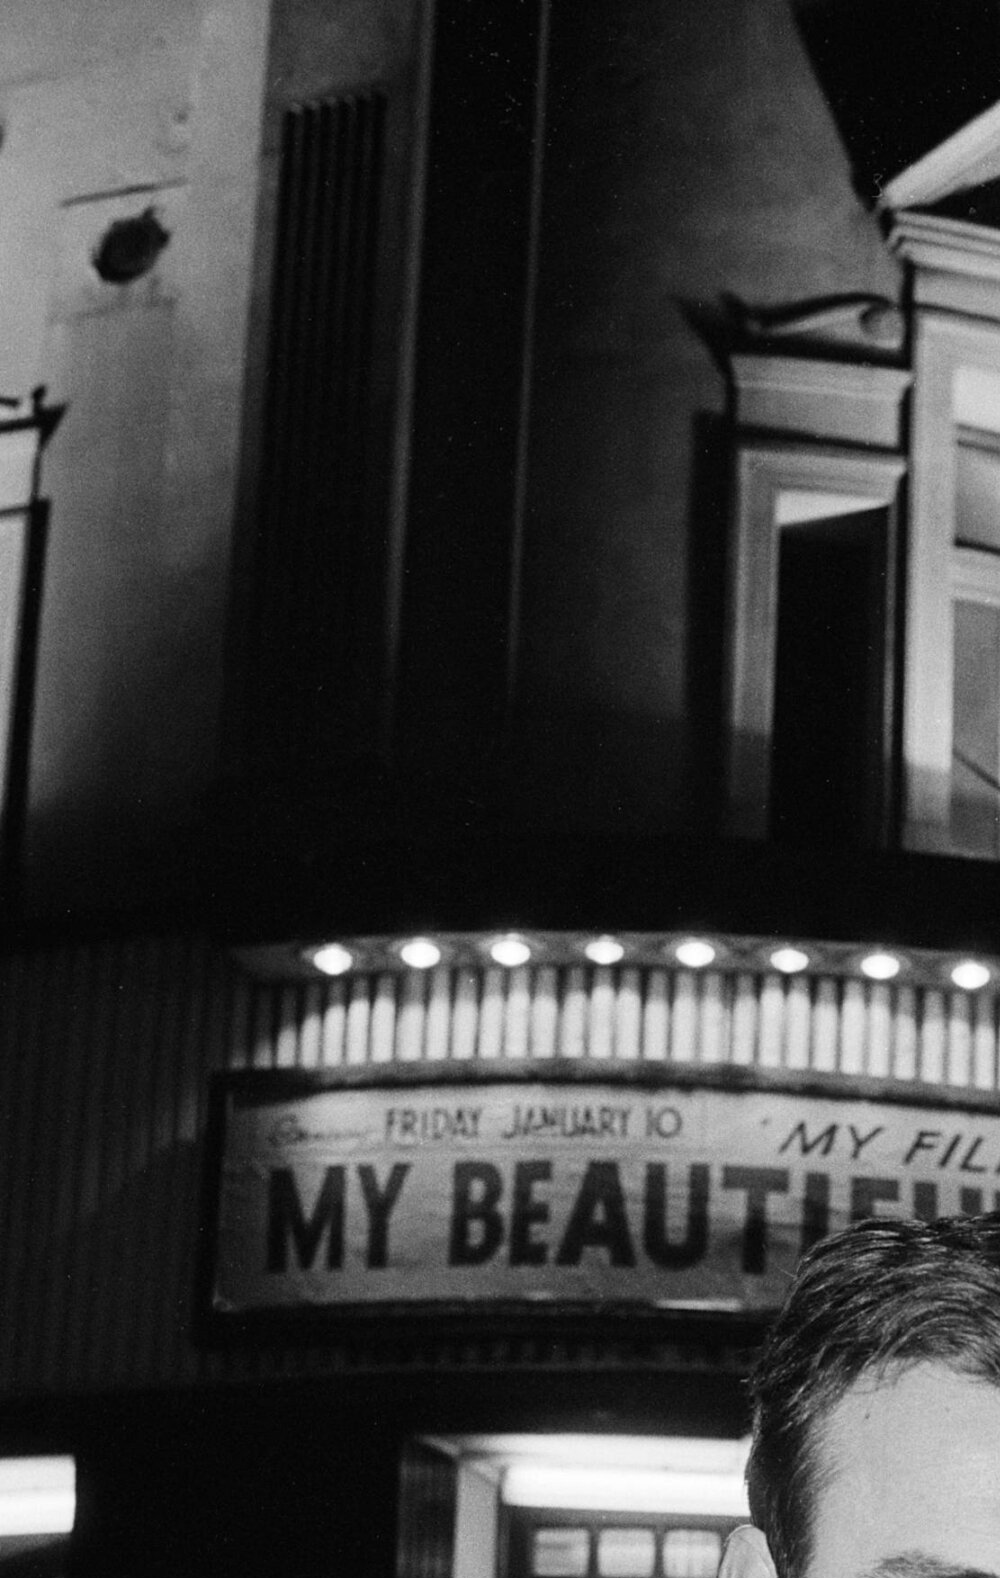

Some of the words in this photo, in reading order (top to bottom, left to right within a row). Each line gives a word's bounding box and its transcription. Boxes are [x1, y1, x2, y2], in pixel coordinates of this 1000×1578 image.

[384, 1106, 483, 1139] FRIDAY
[502, 1104, 631, 1140] JANUARY
[266, 1161, 412, 1274] MY
